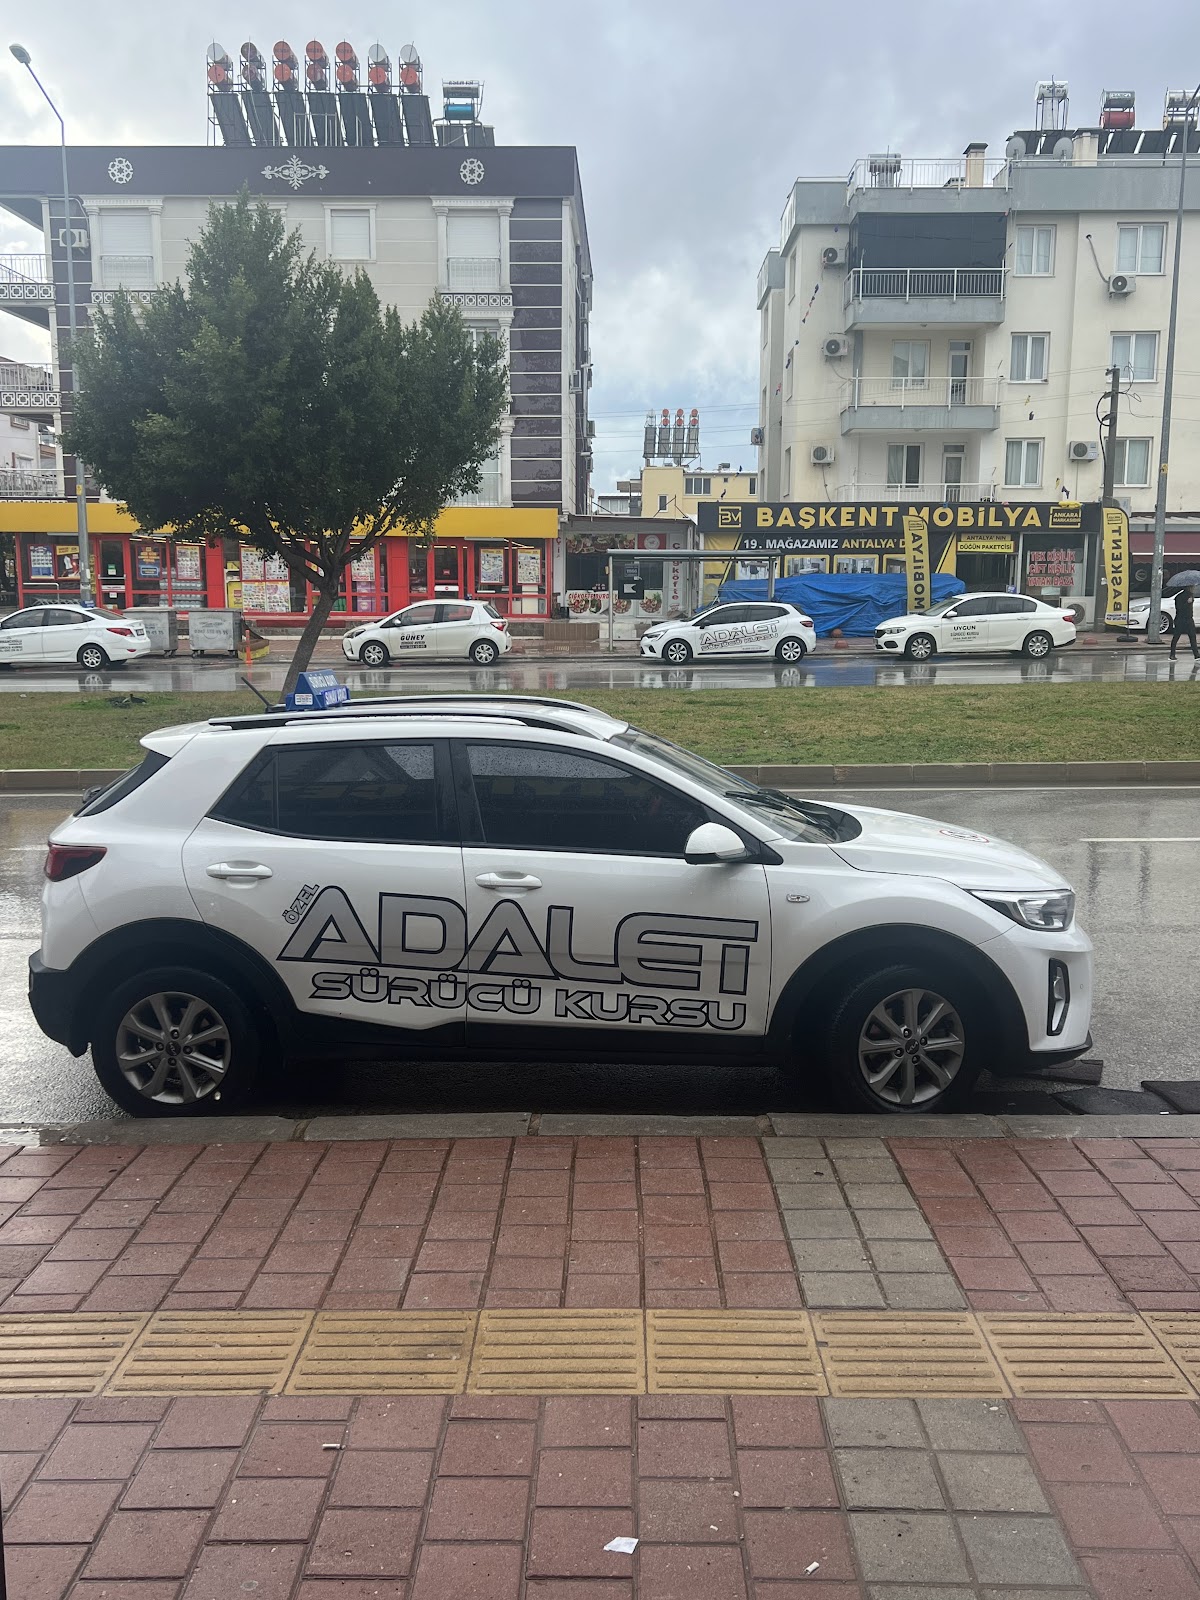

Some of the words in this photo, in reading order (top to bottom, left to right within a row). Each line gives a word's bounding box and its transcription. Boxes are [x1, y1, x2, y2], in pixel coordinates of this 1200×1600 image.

[756, 506, 899, 529] BAŞKENT
[765, 537, 839, 549] MAĞAZAMIZ
[1030, 550, 1046, 561] TEK
[1029, 561, 1047, 575] ÇİFT
[1027, 576, 1052, 587] YATAK
[1053, 576, 1075, 586] BAZA
[281, 883, 320, 925] ÖZEL
[275, 885, 759, 996] ADALET
[308, 967, 542, 1015] SÜRÜCÜ
[554, 988, 747, 1031] KURSU
